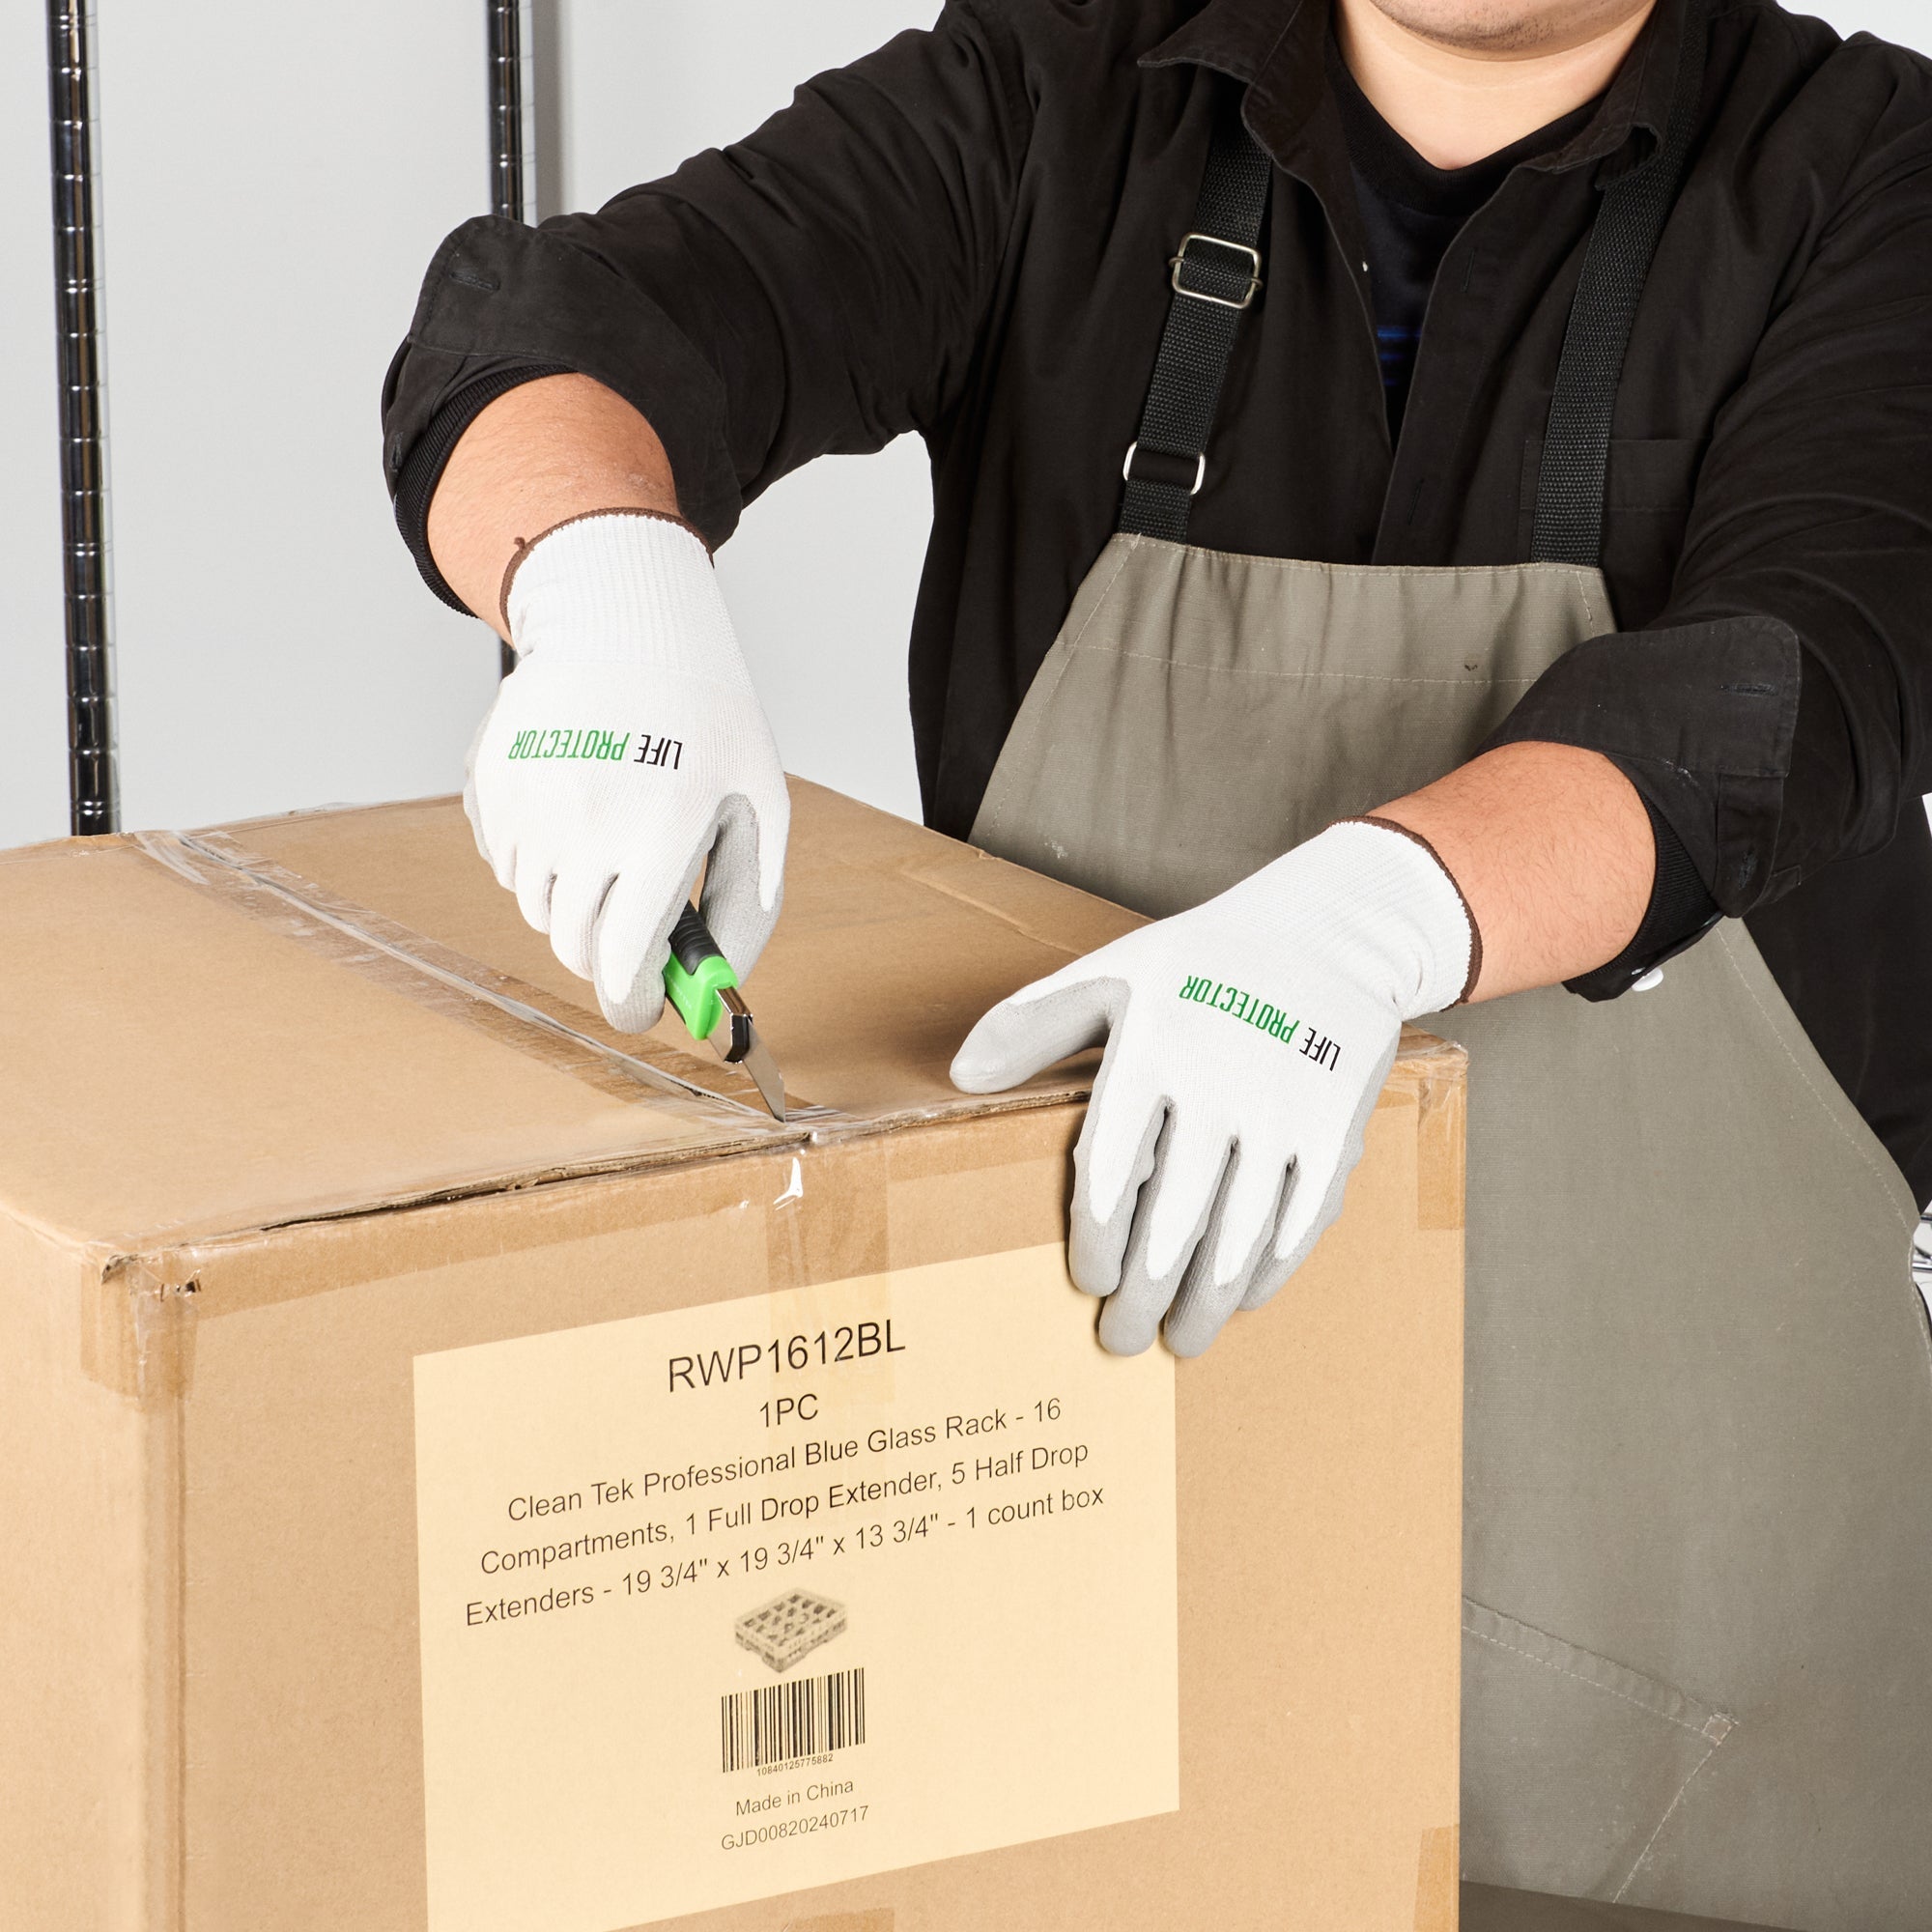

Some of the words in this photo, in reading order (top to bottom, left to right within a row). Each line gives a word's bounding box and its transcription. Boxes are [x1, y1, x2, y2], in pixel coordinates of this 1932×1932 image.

[507, 729, 631, 761] PROTECTOR
[634, 733, 683, 770] LIFE
[1178, 975, 1300, 1044] PROTECTOR
[1298, 1027, 1342, 1072] LIFE
[668, 1318, 906, 1393] RWP1612BL
[758, 1394, 819, 1429] 1PC
[508, 1492, 582, 1521] Clean
[590, 1478, 635, 1506] Tek
[643, 1445, 796, 1497] Professional
[805, 1438, 859, 1465] Blue
[867, 1425, 936, 1453] Glass
[946, 1407, 1008, 1439] Rack
[1033, 1397, 1062, 1423] 16
[480, 1521, 674, 1575] Compartments,
[685, 1513, 696, 1536] 1
[708, 1501, 752, 1532] Full
[761, 1496, 819, 1522] Drop
[828, 1470, 942, 1509] Extender,
[952, 1462, 966, 1486] 5
[975, 1449, 1023, 1481] Half
[1031, 1444, 1089, 1470] Drop
[466, 1585, 594, 1627] Extenders
[621, 1570, 652, 1596] 19
[660, 1558, 708, 1589] 3/4"
[716, 1558, 729, 1578] x
[739, 1547, 768, 1573] 19
[777, 1535, 824, 1566] 3/4"
[832, 1535, 845, 1555] x
[855, 1523, 884, 1550] 13
[893, 1513, 939, 1544] 3/4"
[966, 1507, 977, 1529] 1
[987, 1492, 1054, 1526] count
[1062, 1488, 1104, 1512] box
[756, 1753, 834, 1777] 10840125775882
[735, 1794, 782, 1817] Made
[787, 1789, 801, 1805] in
[806, 1779, 854, 1801] China
[721, 1804, 869, 1851] GJD00820240717
